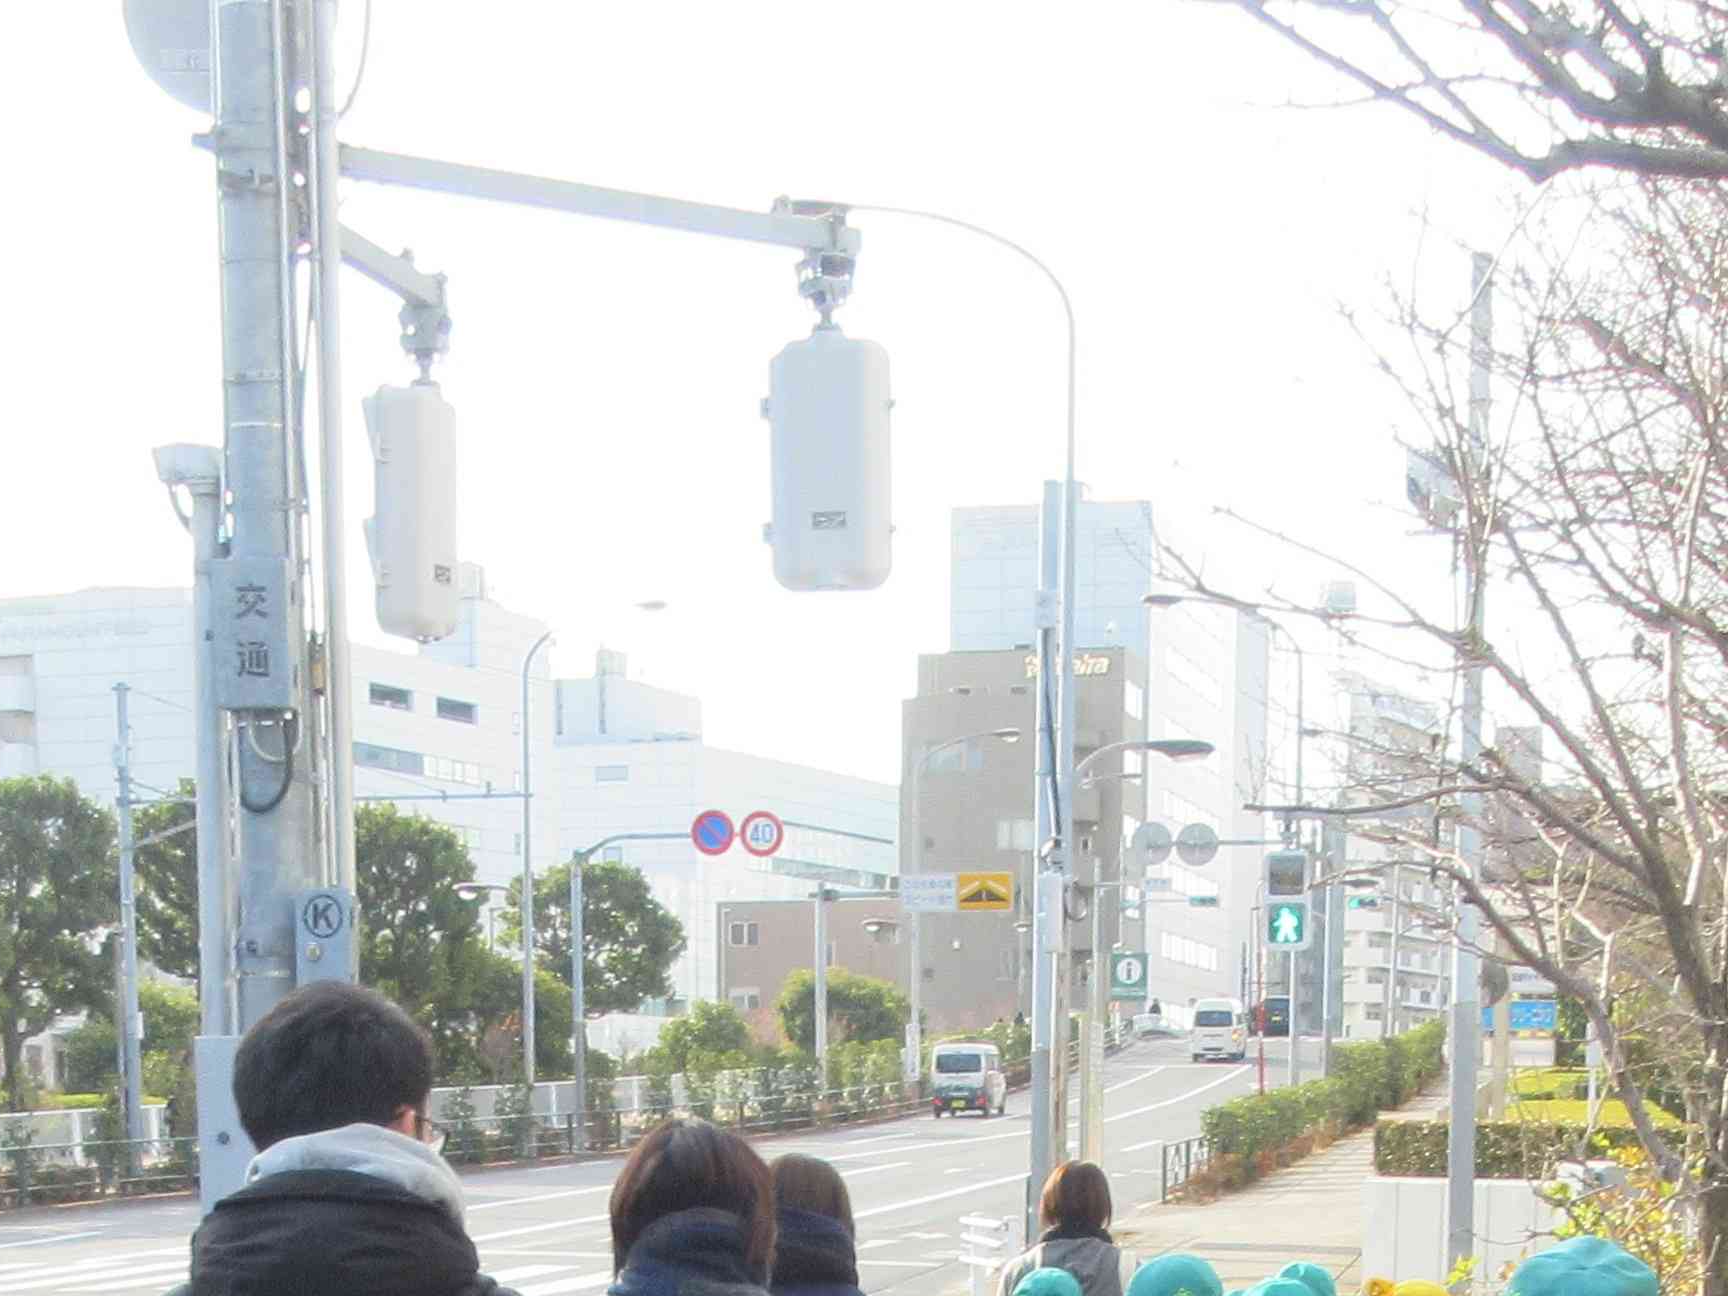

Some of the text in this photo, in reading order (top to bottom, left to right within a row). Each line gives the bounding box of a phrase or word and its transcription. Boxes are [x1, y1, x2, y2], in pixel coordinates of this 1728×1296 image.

[235, 584, 270, 677] 交通
[750, 823, 774, 843] 40
[312, 903, 334, 929] K
